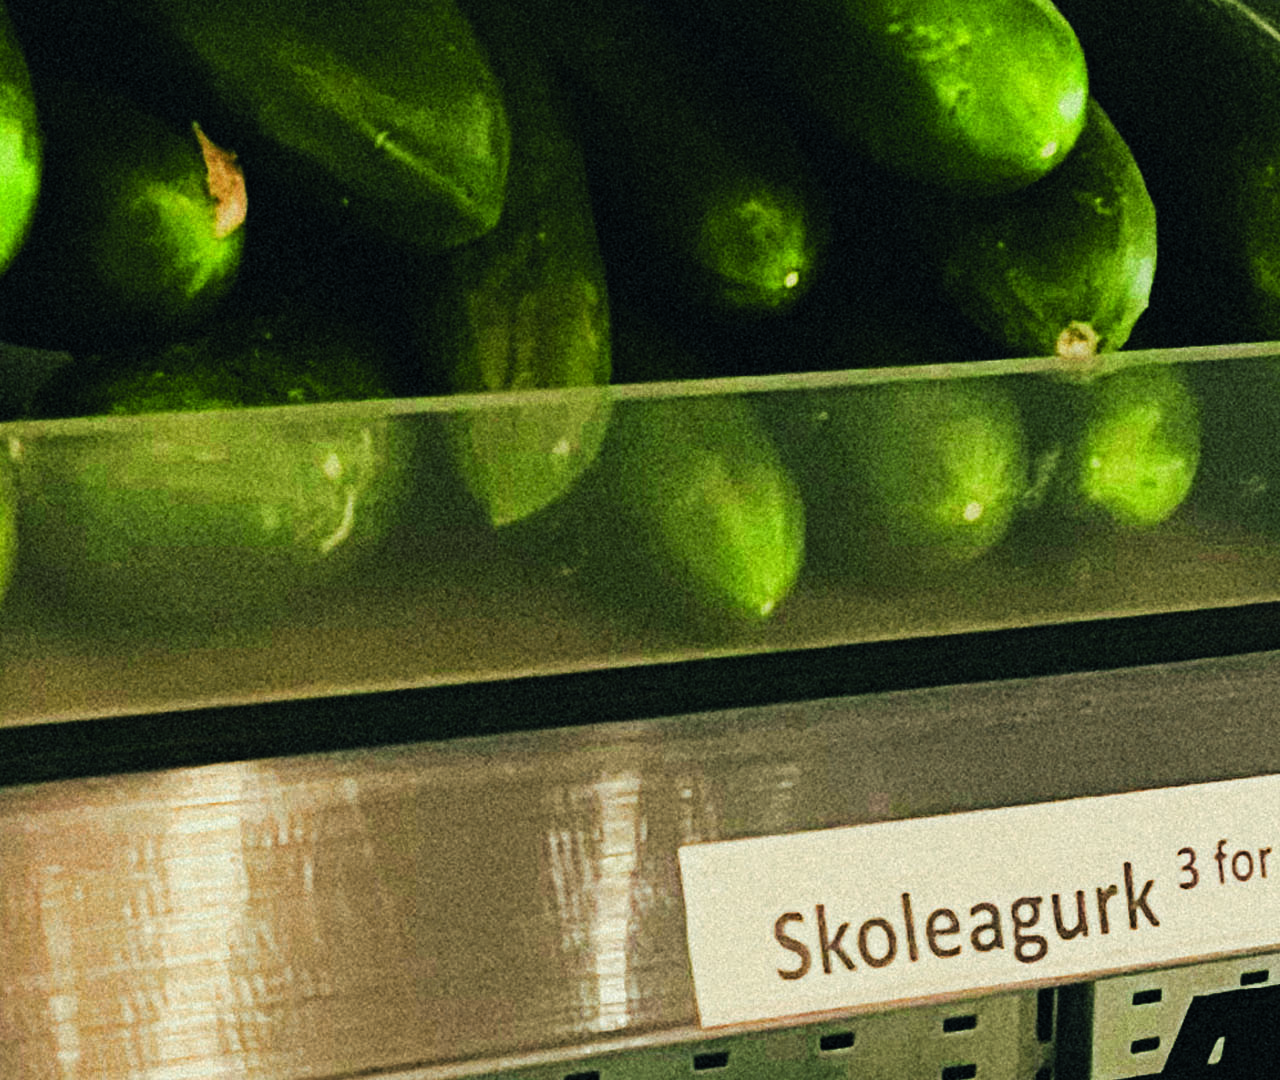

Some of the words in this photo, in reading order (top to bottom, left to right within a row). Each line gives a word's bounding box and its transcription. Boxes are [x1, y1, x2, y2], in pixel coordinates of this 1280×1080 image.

[773, 860, 1161, 981] Skoleagurk
[1176, 847, 1200, 890] 3
[1213, 838, 1274, 885] for
